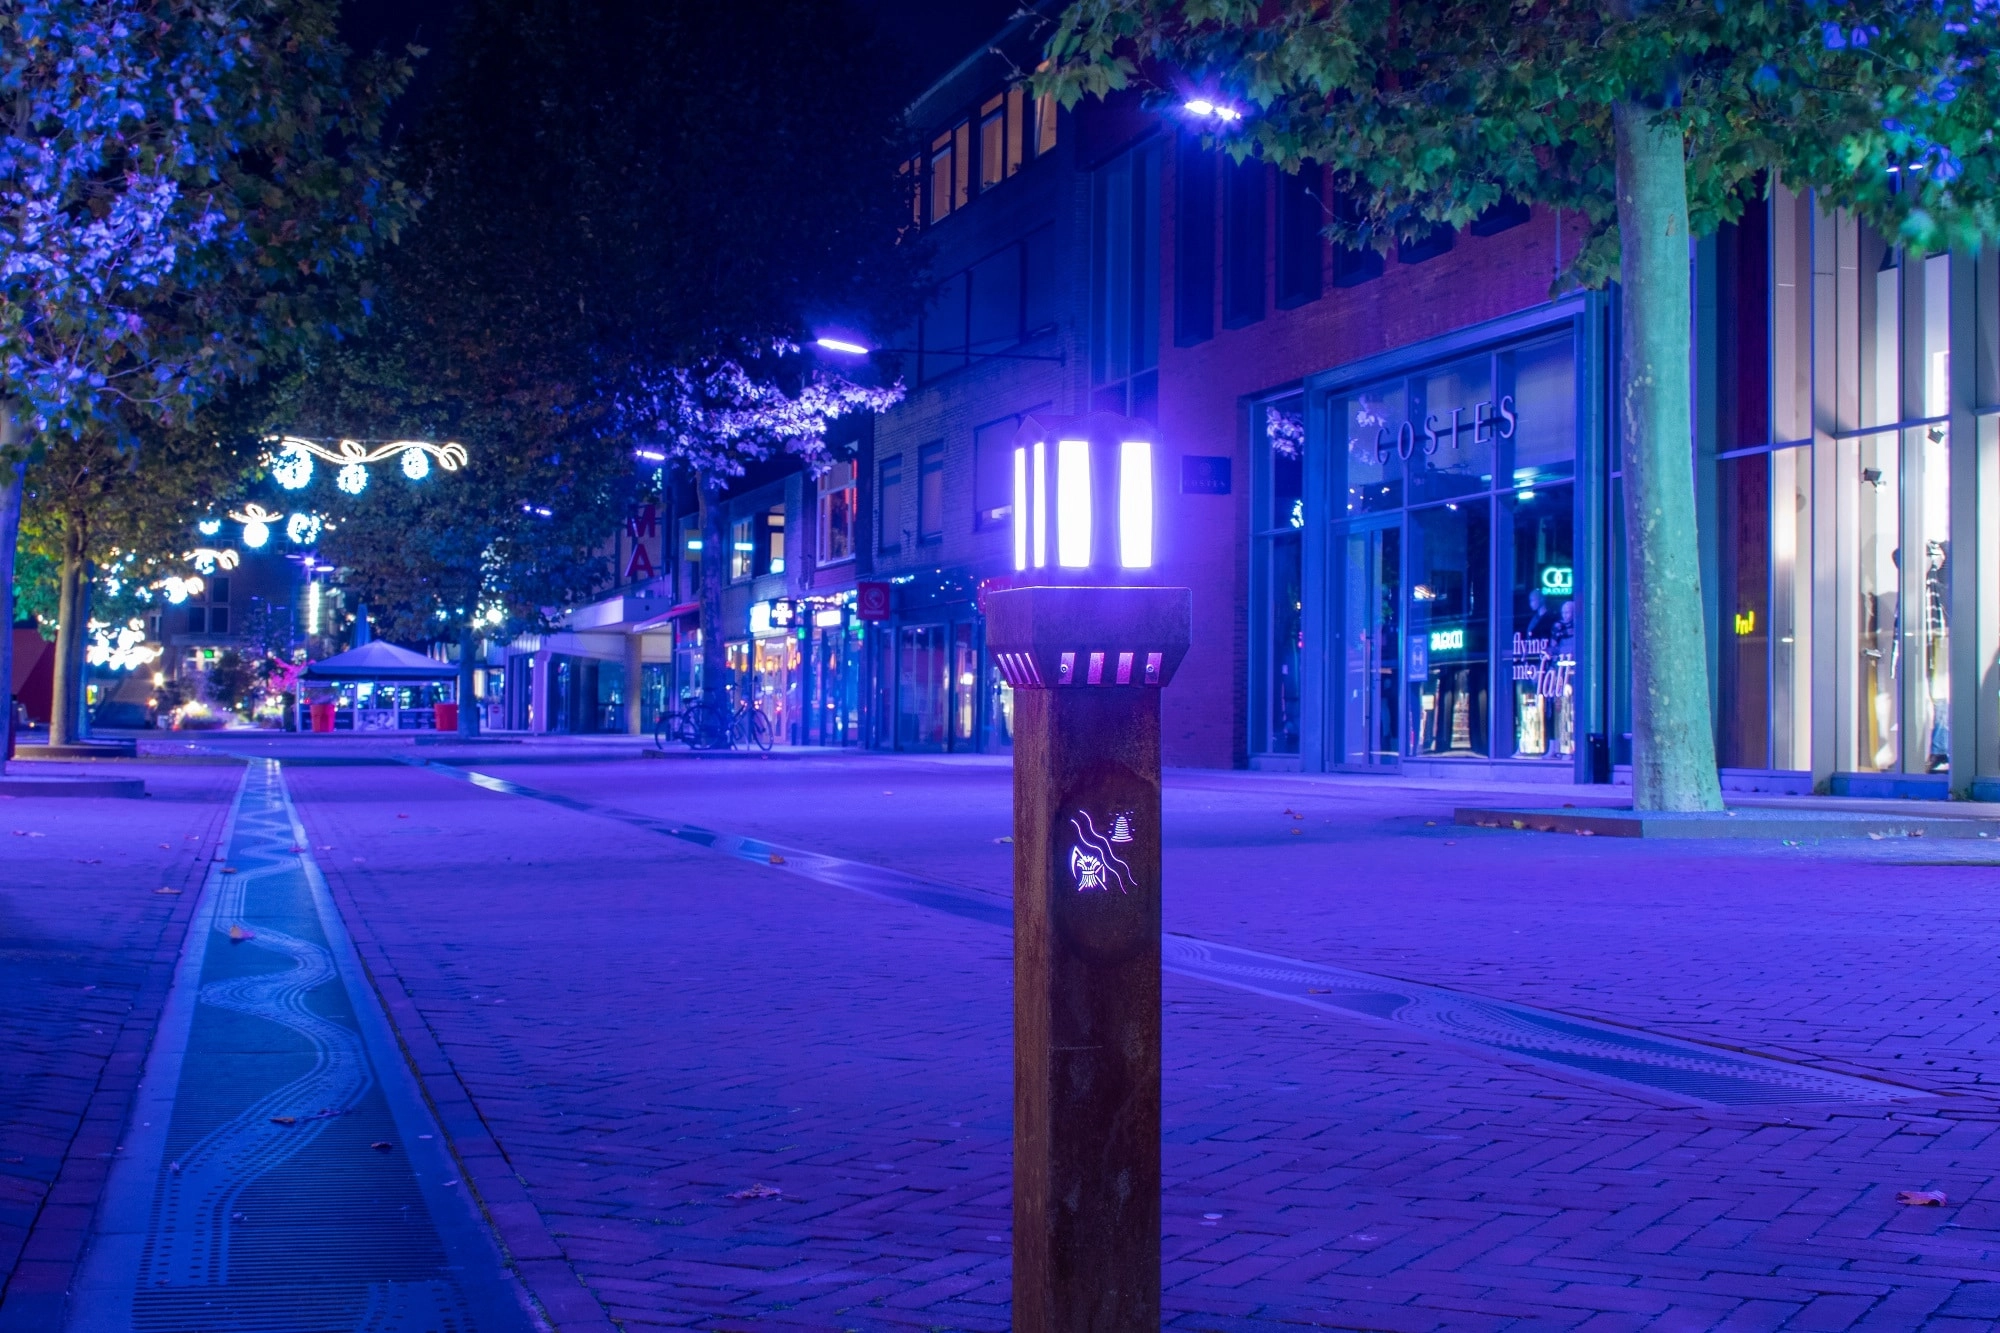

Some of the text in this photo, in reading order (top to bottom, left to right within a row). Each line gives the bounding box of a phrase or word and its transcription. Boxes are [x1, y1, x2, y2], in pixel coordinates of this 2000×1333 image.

[1376, 396, 1516, 464] COSTES
[1513, 631, 1550, 662] flying
[1513, 653, 1573, 698] into fall
